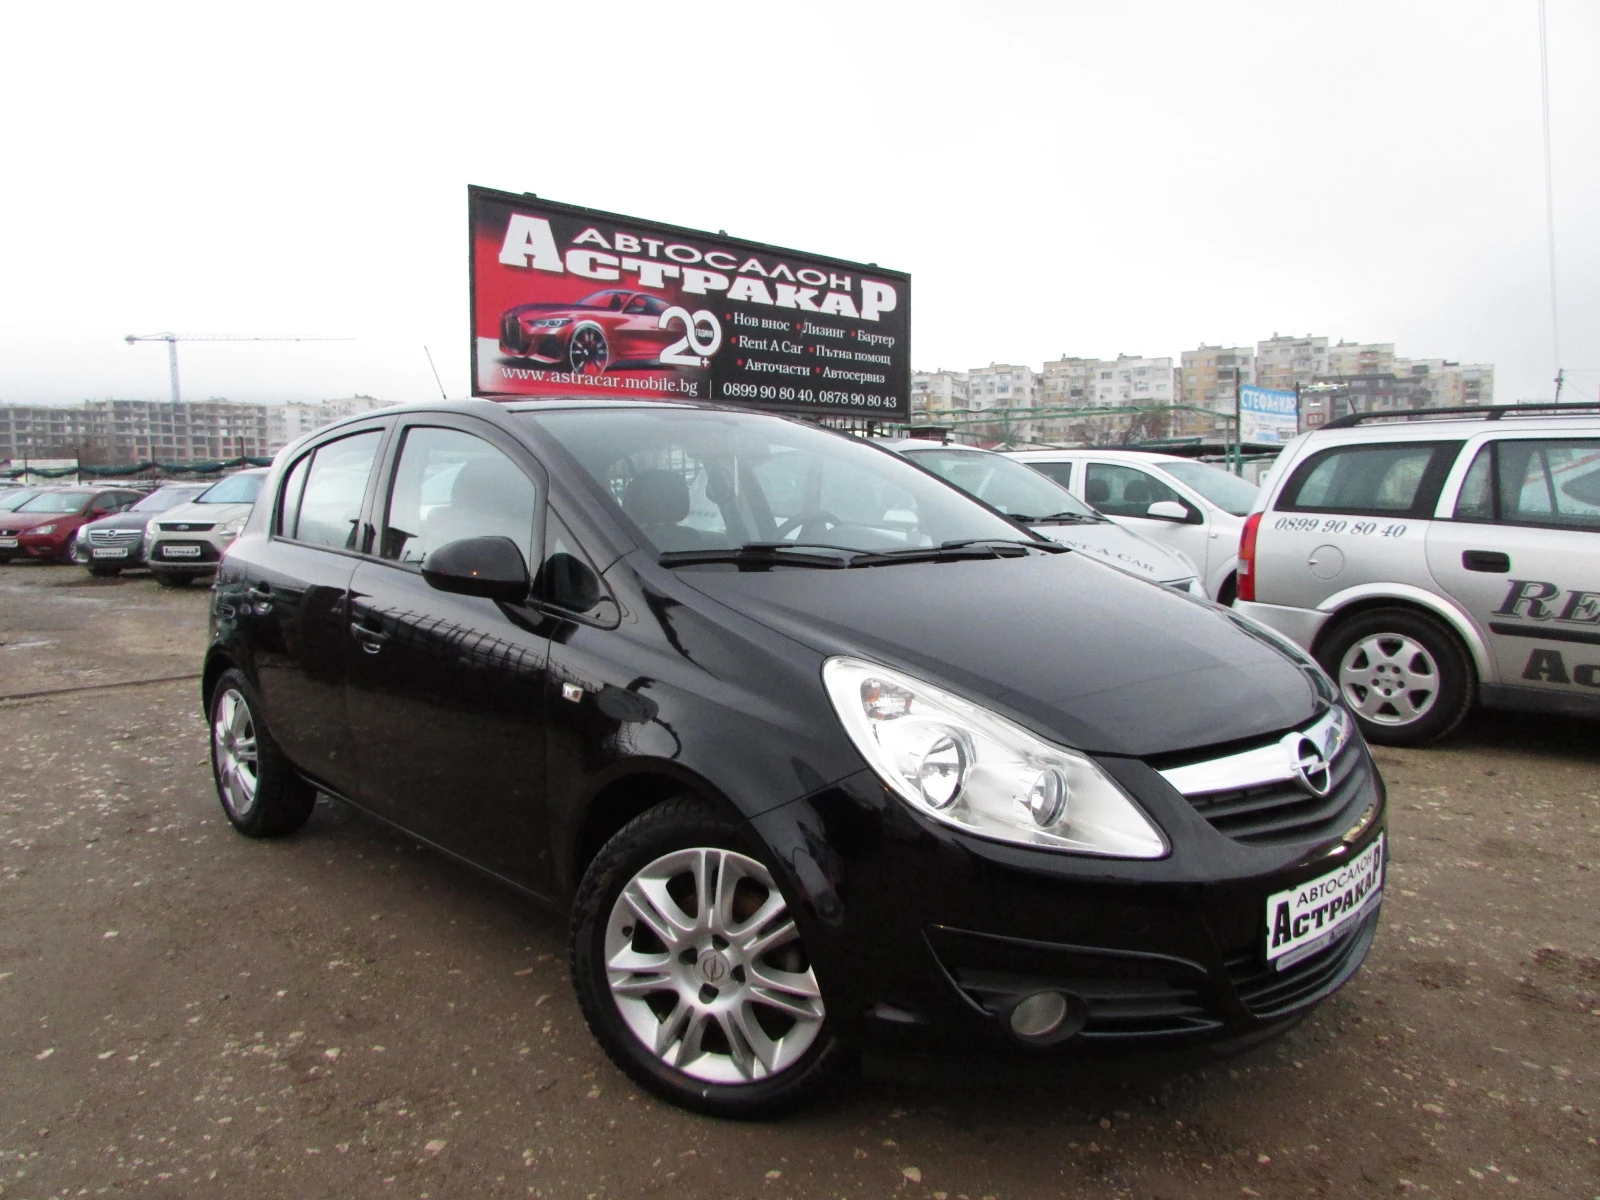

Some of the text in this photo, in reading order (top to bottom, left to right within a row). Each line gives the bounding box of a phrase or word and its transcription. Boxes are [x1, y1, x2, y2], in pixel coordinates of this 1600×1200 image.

[572, 228, 851, 291] АВТОСАЛОН
[733, 312, 895, 348] Нов внос Лизинг Бартер
[739, 336, 803, 355] Rent A Car
[816, 345, 891, 366] Пътна помощ
[501, 367, 698, 396] www.astracar.mobile.bg
[745, 358, 885, 384] Авточасти Автосервиз
[723, 382, 897, 408] 0899 90 80 40, 0878 90 80 43
[1274, 517, 1407, 538] 0899 90 80 40
[1117, 553, 1155, 573] CAR
[1296, 854, 1372, 908] АВТОСАЛОН
